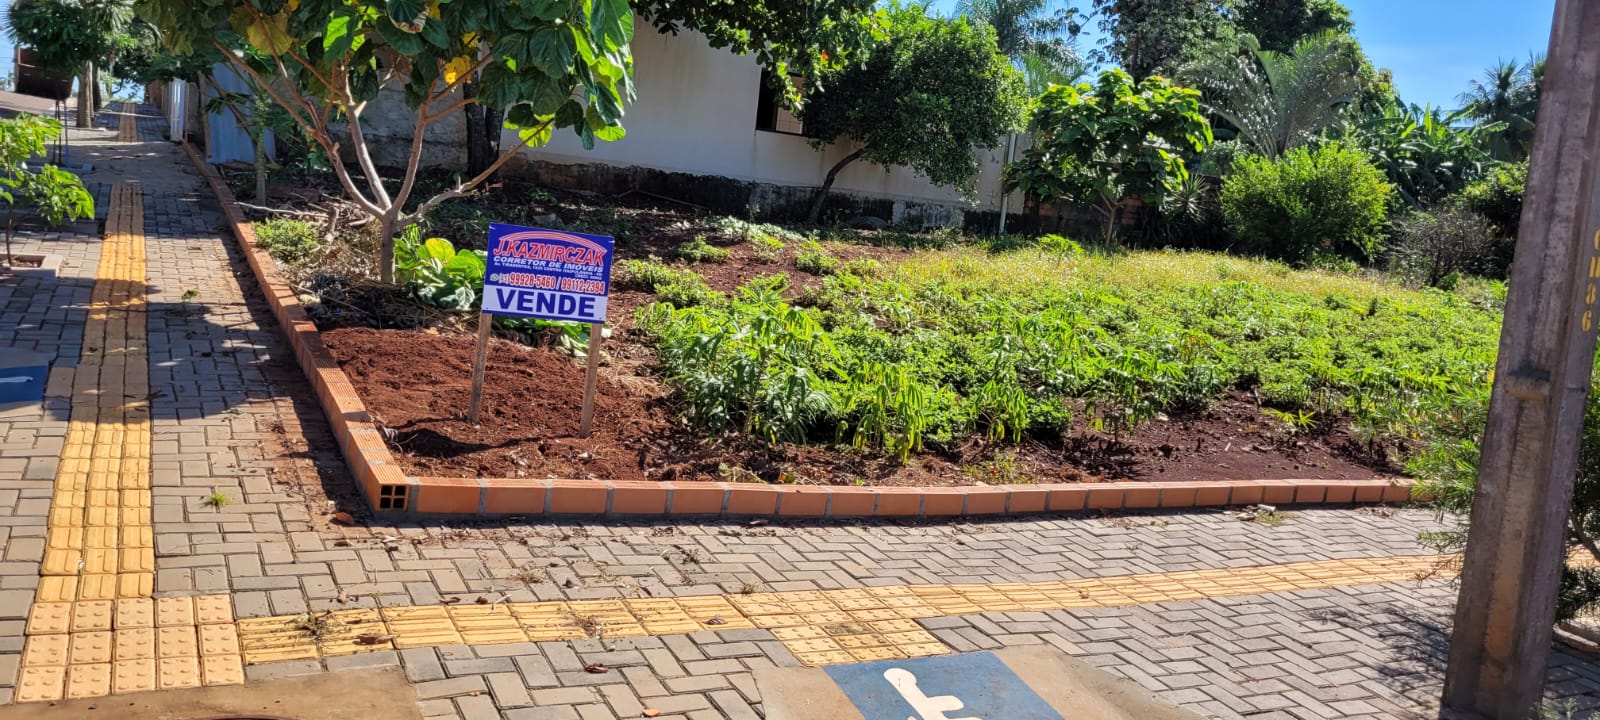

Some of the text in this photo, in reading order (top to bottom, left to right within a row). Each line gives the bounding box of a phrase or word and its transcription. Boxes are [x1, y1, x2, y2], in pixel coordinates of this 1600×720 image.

[493, 239, 604, 266] J.KAZMIRCZAK
[493, 256, 546, 267] CORRETOR
[510, 272, 556, 289] 99928-5460
[561, 277, 606, 295] 99112-2394
[496, 288, 596, 317] VENDE
